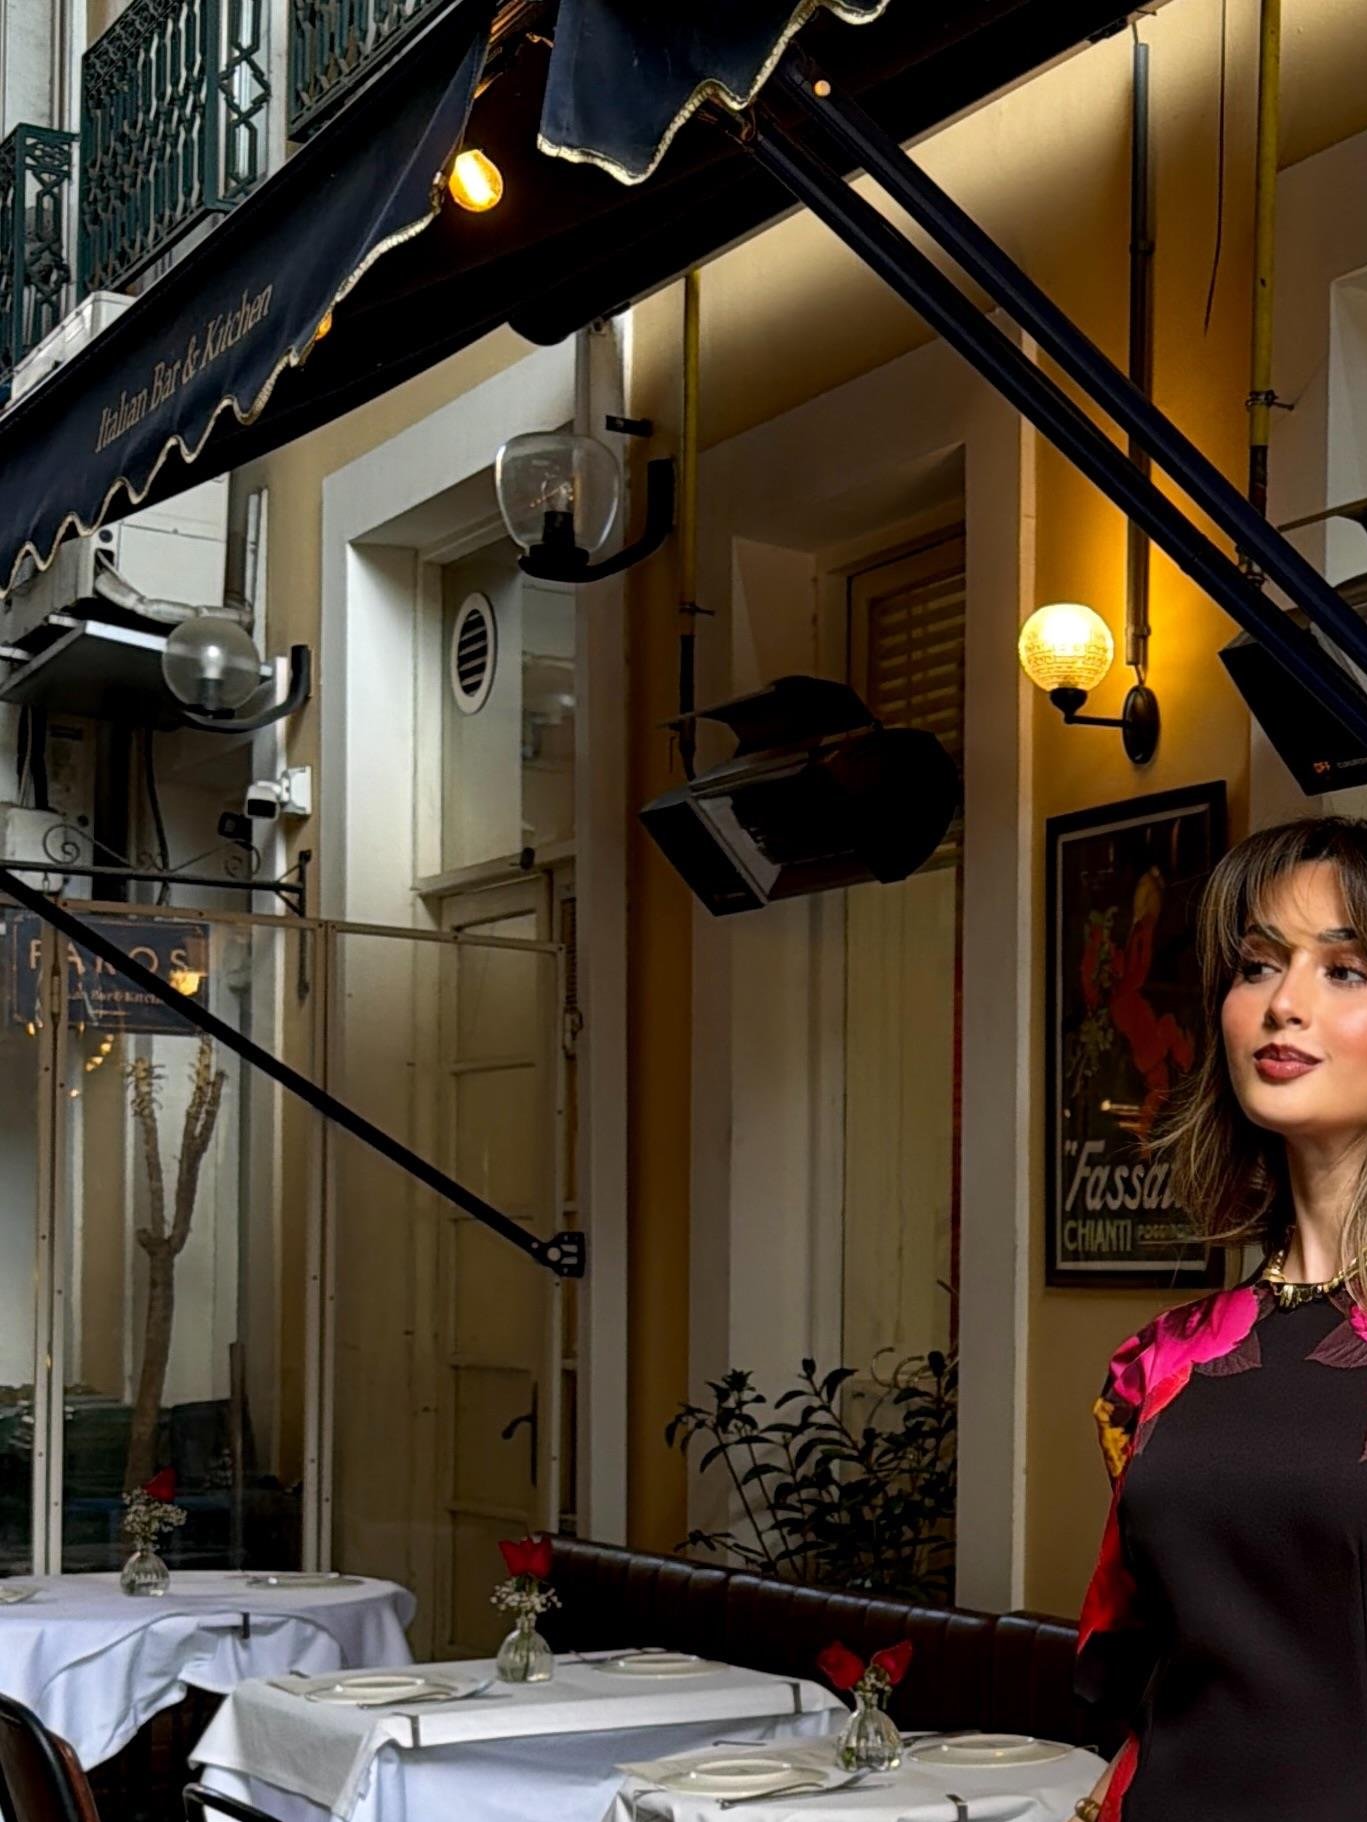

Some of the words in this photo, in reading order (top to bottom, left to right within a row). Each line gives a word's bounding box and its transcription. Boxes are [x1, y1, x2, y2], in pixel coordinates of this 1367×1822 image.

[95, 388, 148, 453] Italian
[150, 361, 181, 411] Bar
[182, 335, 200, 385] &
[200, 284, 273, 370] Kitchen
[1064, 1218, 1133, 1252] CHIANTI
